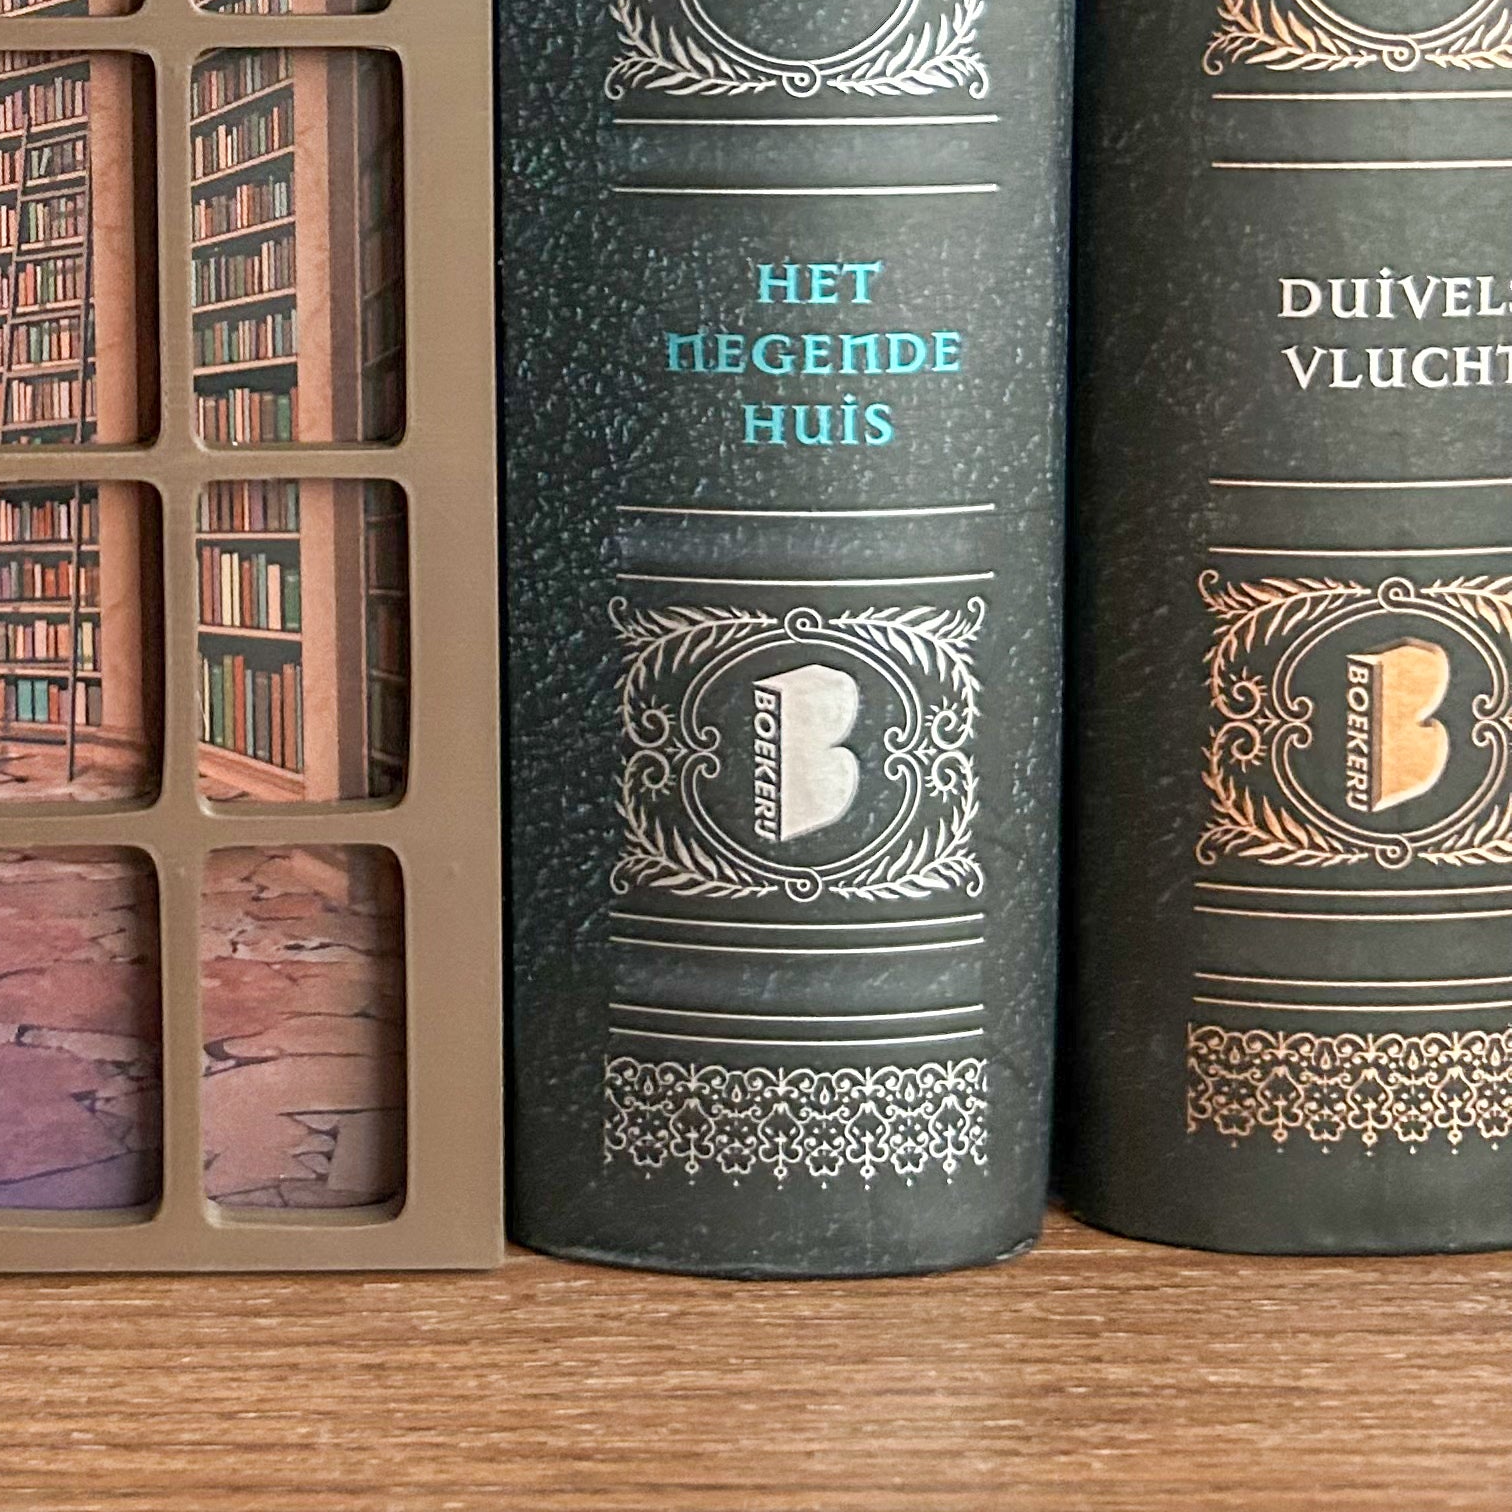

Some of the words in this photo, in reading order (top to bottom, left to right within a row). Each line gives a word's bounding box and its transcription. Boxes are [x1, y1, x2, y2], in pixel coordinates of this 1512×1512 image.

[756, 261, 882, 305] HET
[1277, 266, 1512, 320] DUIVEL
[666, 329, 962, 376] NEGENDE
[742, 394, 896, 447] HUIS
